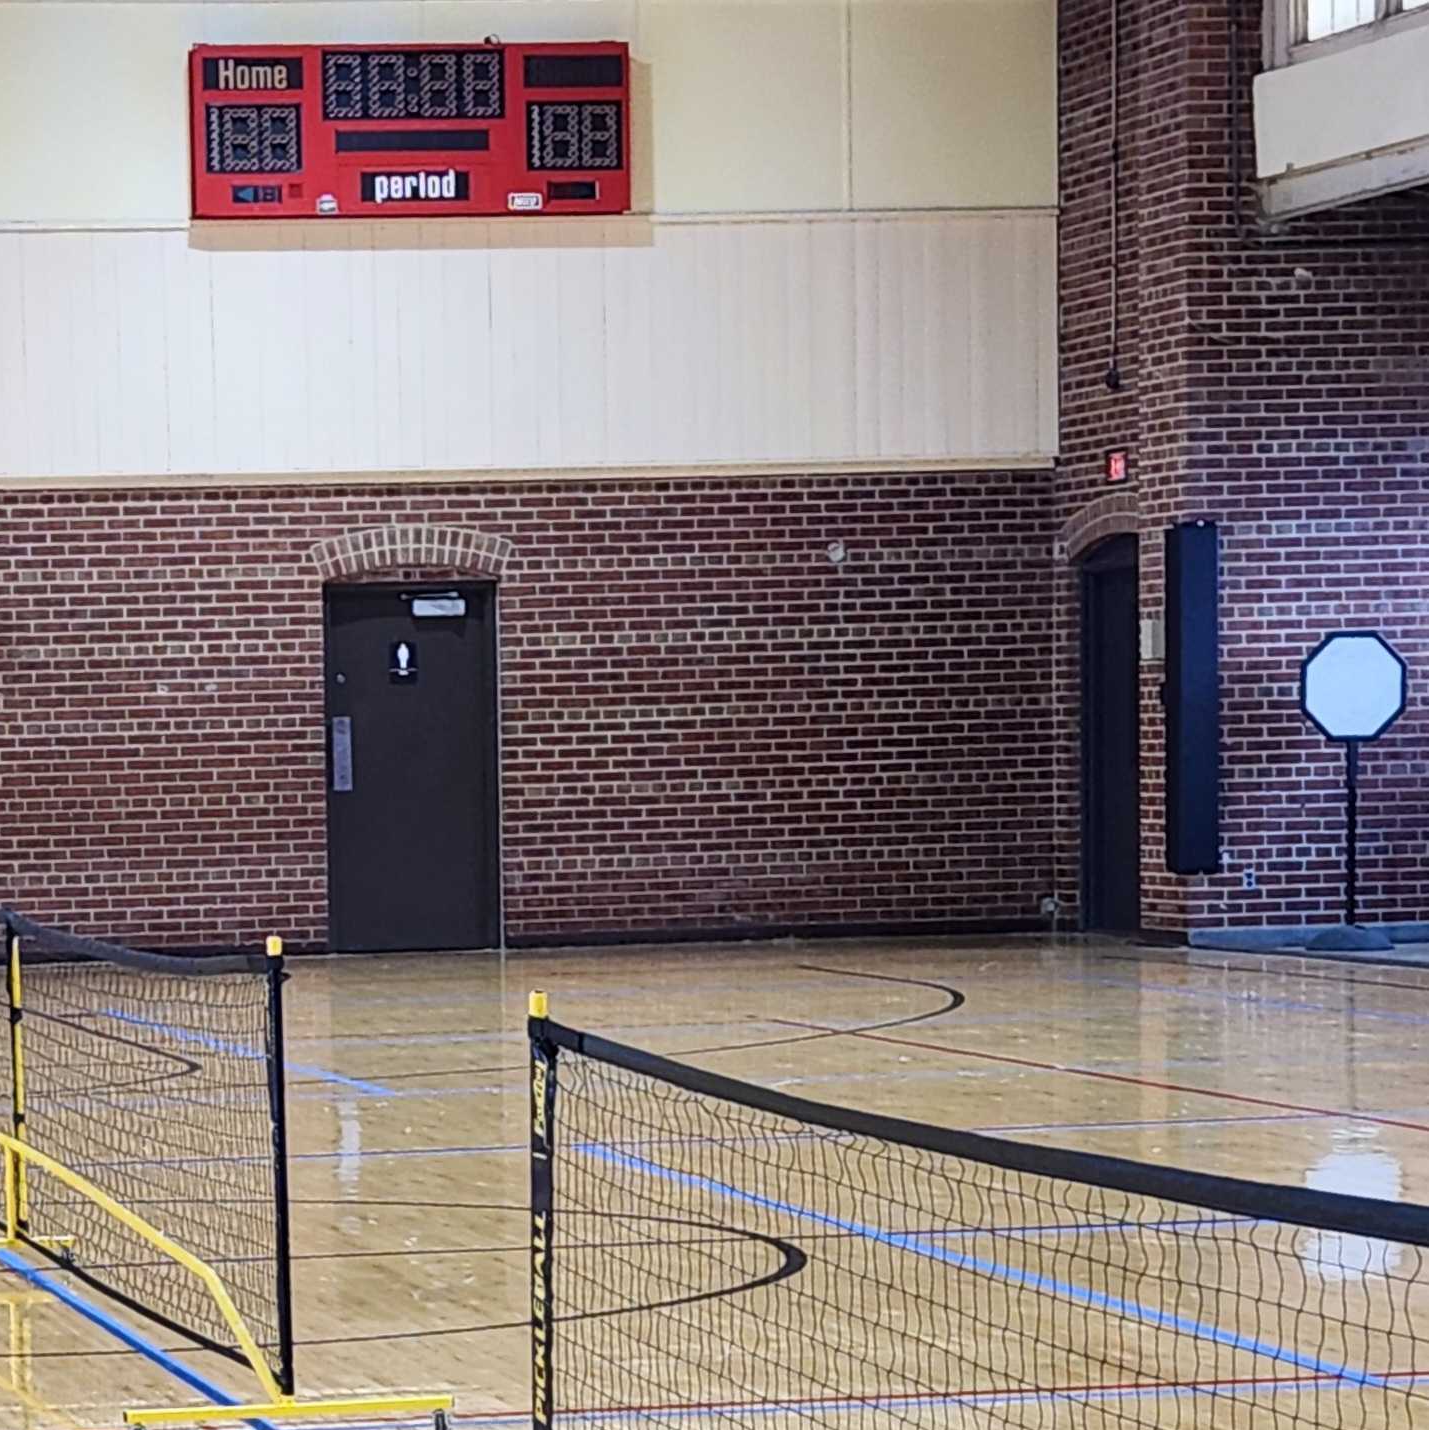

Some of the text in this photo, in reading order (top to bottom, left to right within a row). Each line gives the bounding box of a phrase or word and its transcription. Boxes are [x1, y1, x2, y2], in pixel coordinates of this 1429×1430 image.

[218, 59, 288, 90] Home
[374, 168, 456, 204] period
[533, 1210, 547, 1425] PICKLEBALL
